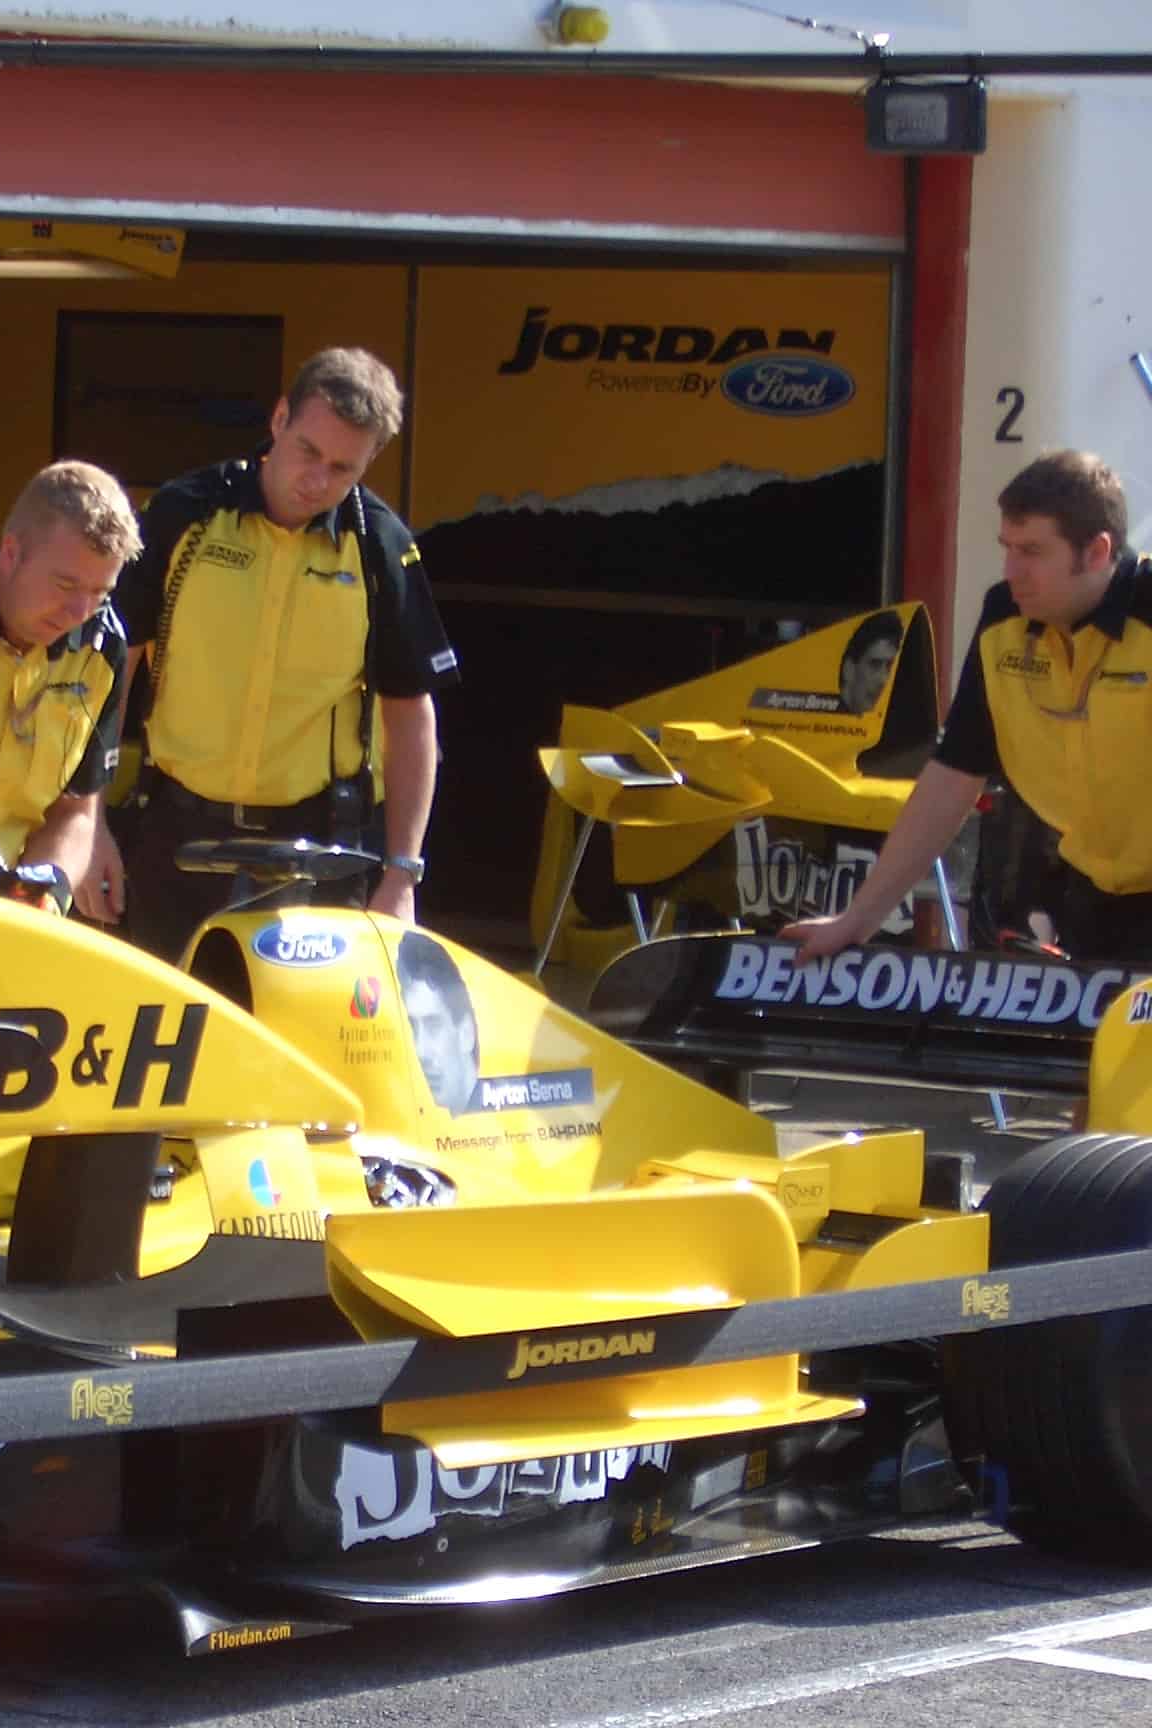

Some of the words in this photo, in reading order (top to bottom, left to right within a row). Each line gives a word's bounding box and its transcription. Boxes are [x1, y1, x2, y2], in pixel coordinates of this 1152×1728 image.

[746, 357, 830, 407] Ford
[995, 387, 1025, 443] 2
[276, 931, 339, 961] Ford
[482, 1081, 530, 1110] Ayrton
[530, 1079, 573, 1101] Senna
[436, 1134, 502, 1152] Message
[537, 1121, 603, 1142] BAHRAIN
